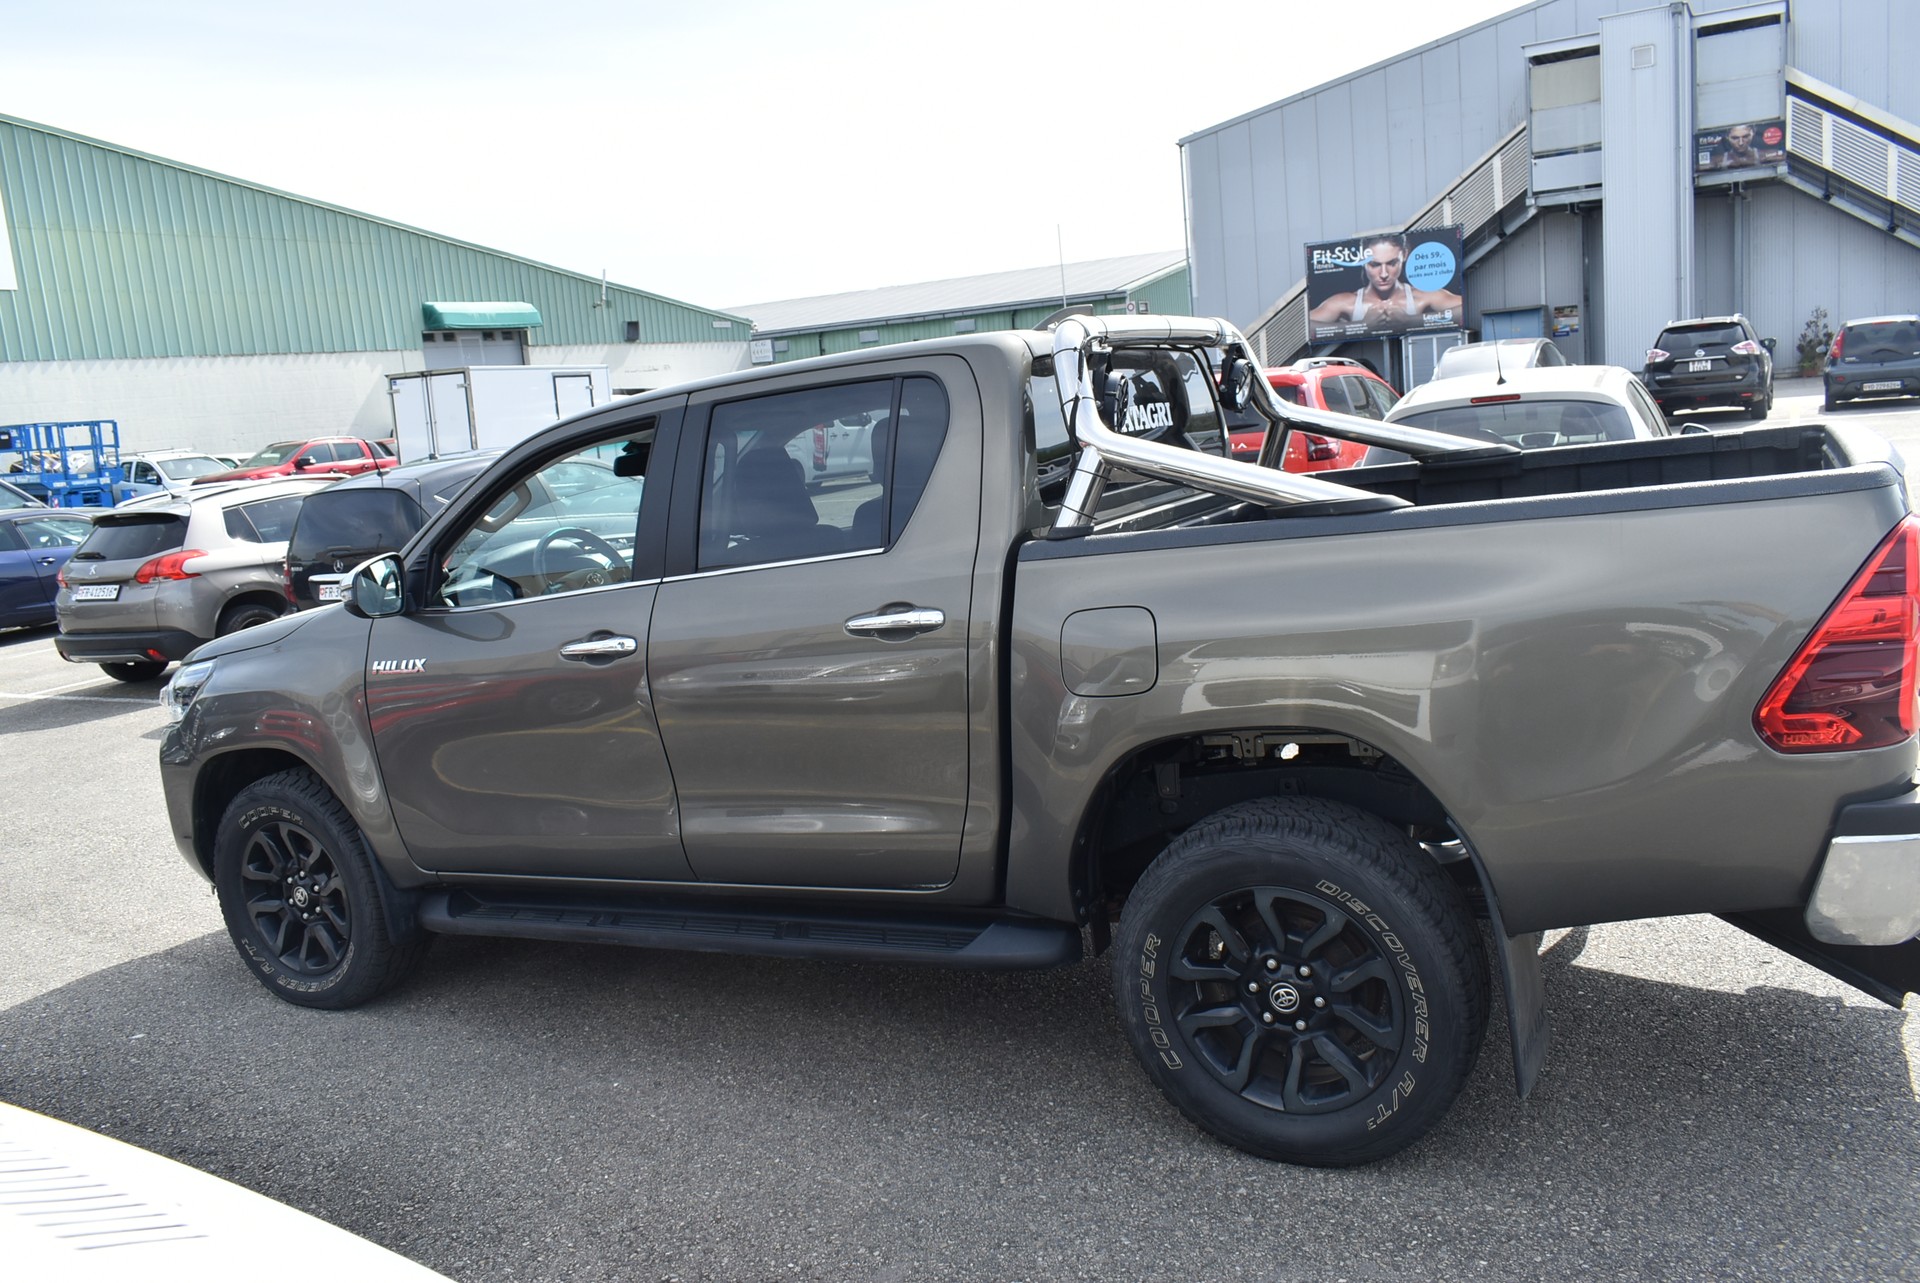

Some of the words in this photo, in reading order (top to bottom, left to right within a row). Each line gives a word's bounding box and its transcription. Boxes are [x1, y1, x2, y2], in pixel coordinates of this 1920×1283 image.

[1313, 246, 1373, 265] Fit-Style
[1414, 264, 1427, 272] par
[1428, 261, 1447, 269] mois
[372, 658, 427, 675] HILUX
[238, 806, 304, 830] COOPER
[1315, 878, 1430, 1065] DISCOVERER
[1141, 932, 1184, 1071] COOPER
